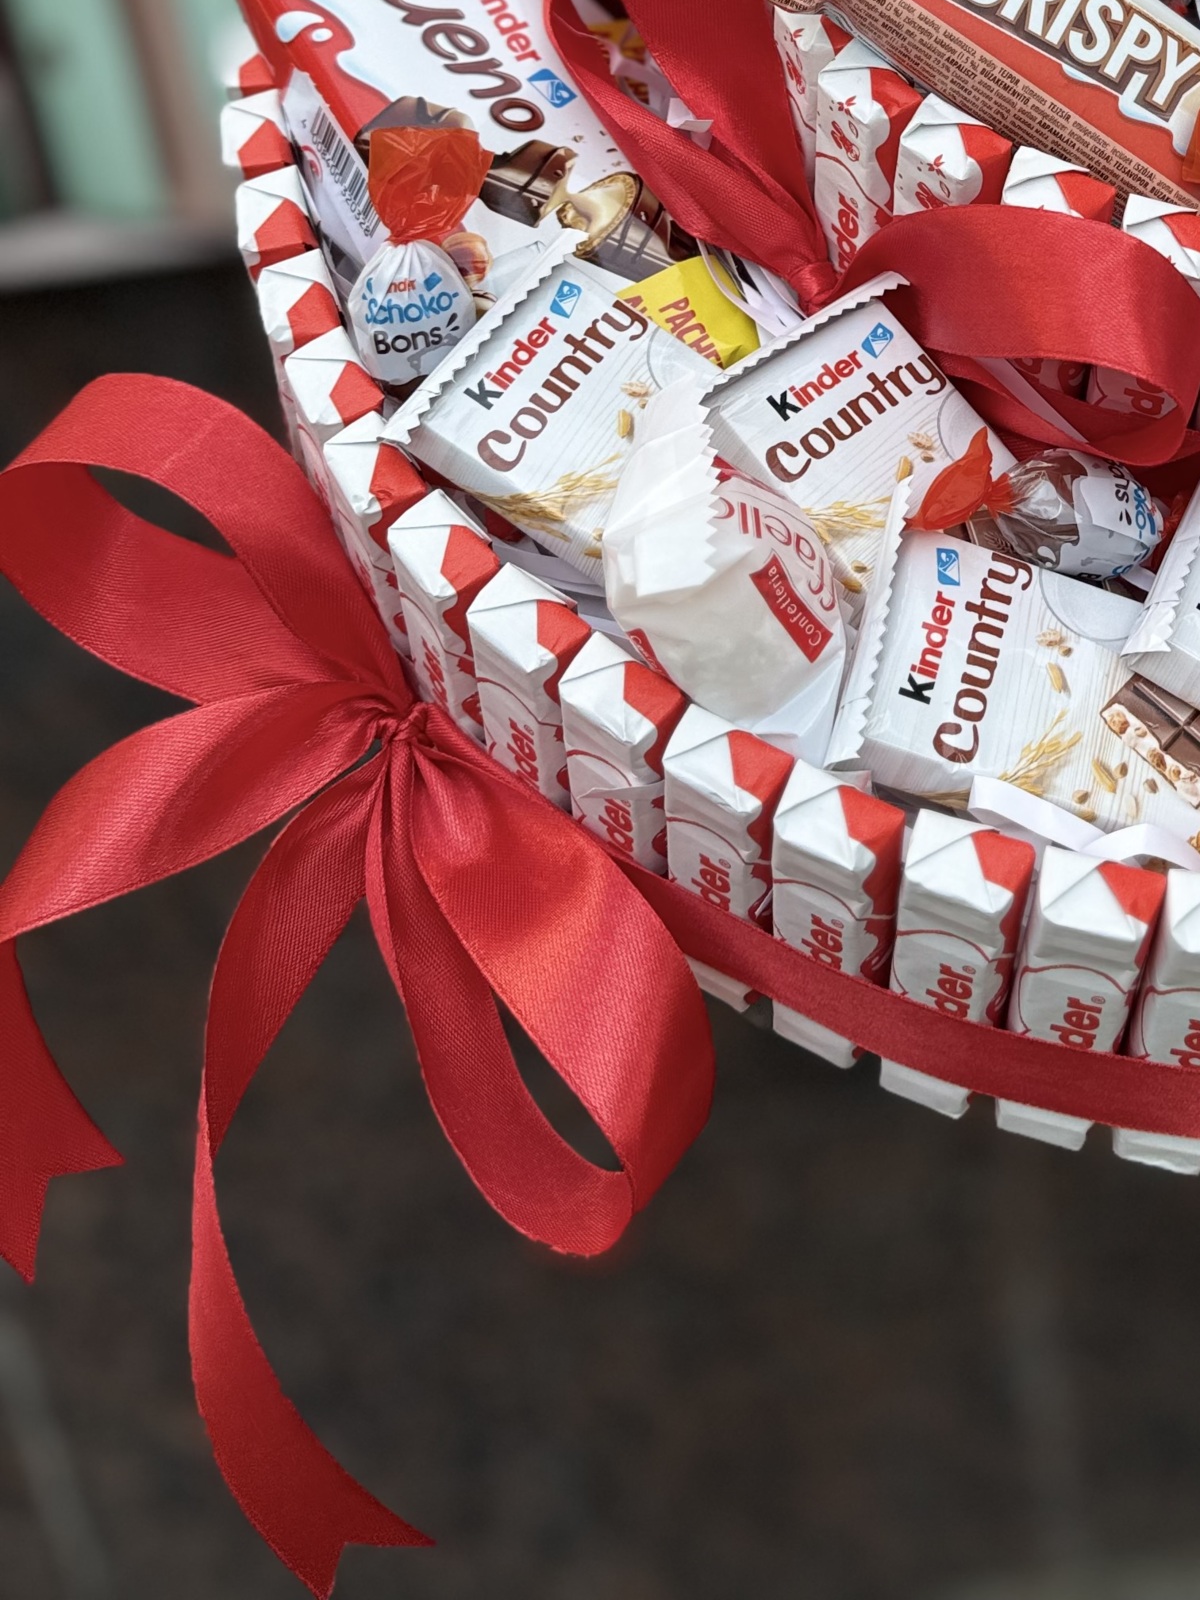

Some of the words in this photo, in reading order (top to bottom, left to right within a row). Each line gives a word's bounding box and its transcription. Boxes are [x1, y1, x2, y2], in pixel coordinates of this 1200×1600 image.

[365, 291, 460, 325] Schoko-
[373, 326, 443, 355] Bons
[462, 315, 558, 411] Kinder
[476, 299, 651, 474] Country
[765, 347, 863, 422] Kinder
[764, 349, 948, 484] Country
[767, 564, 823, 647] Confetteria
[897, 590, 956, 706] Kinder
[931, 551, 1034, 765] Country
